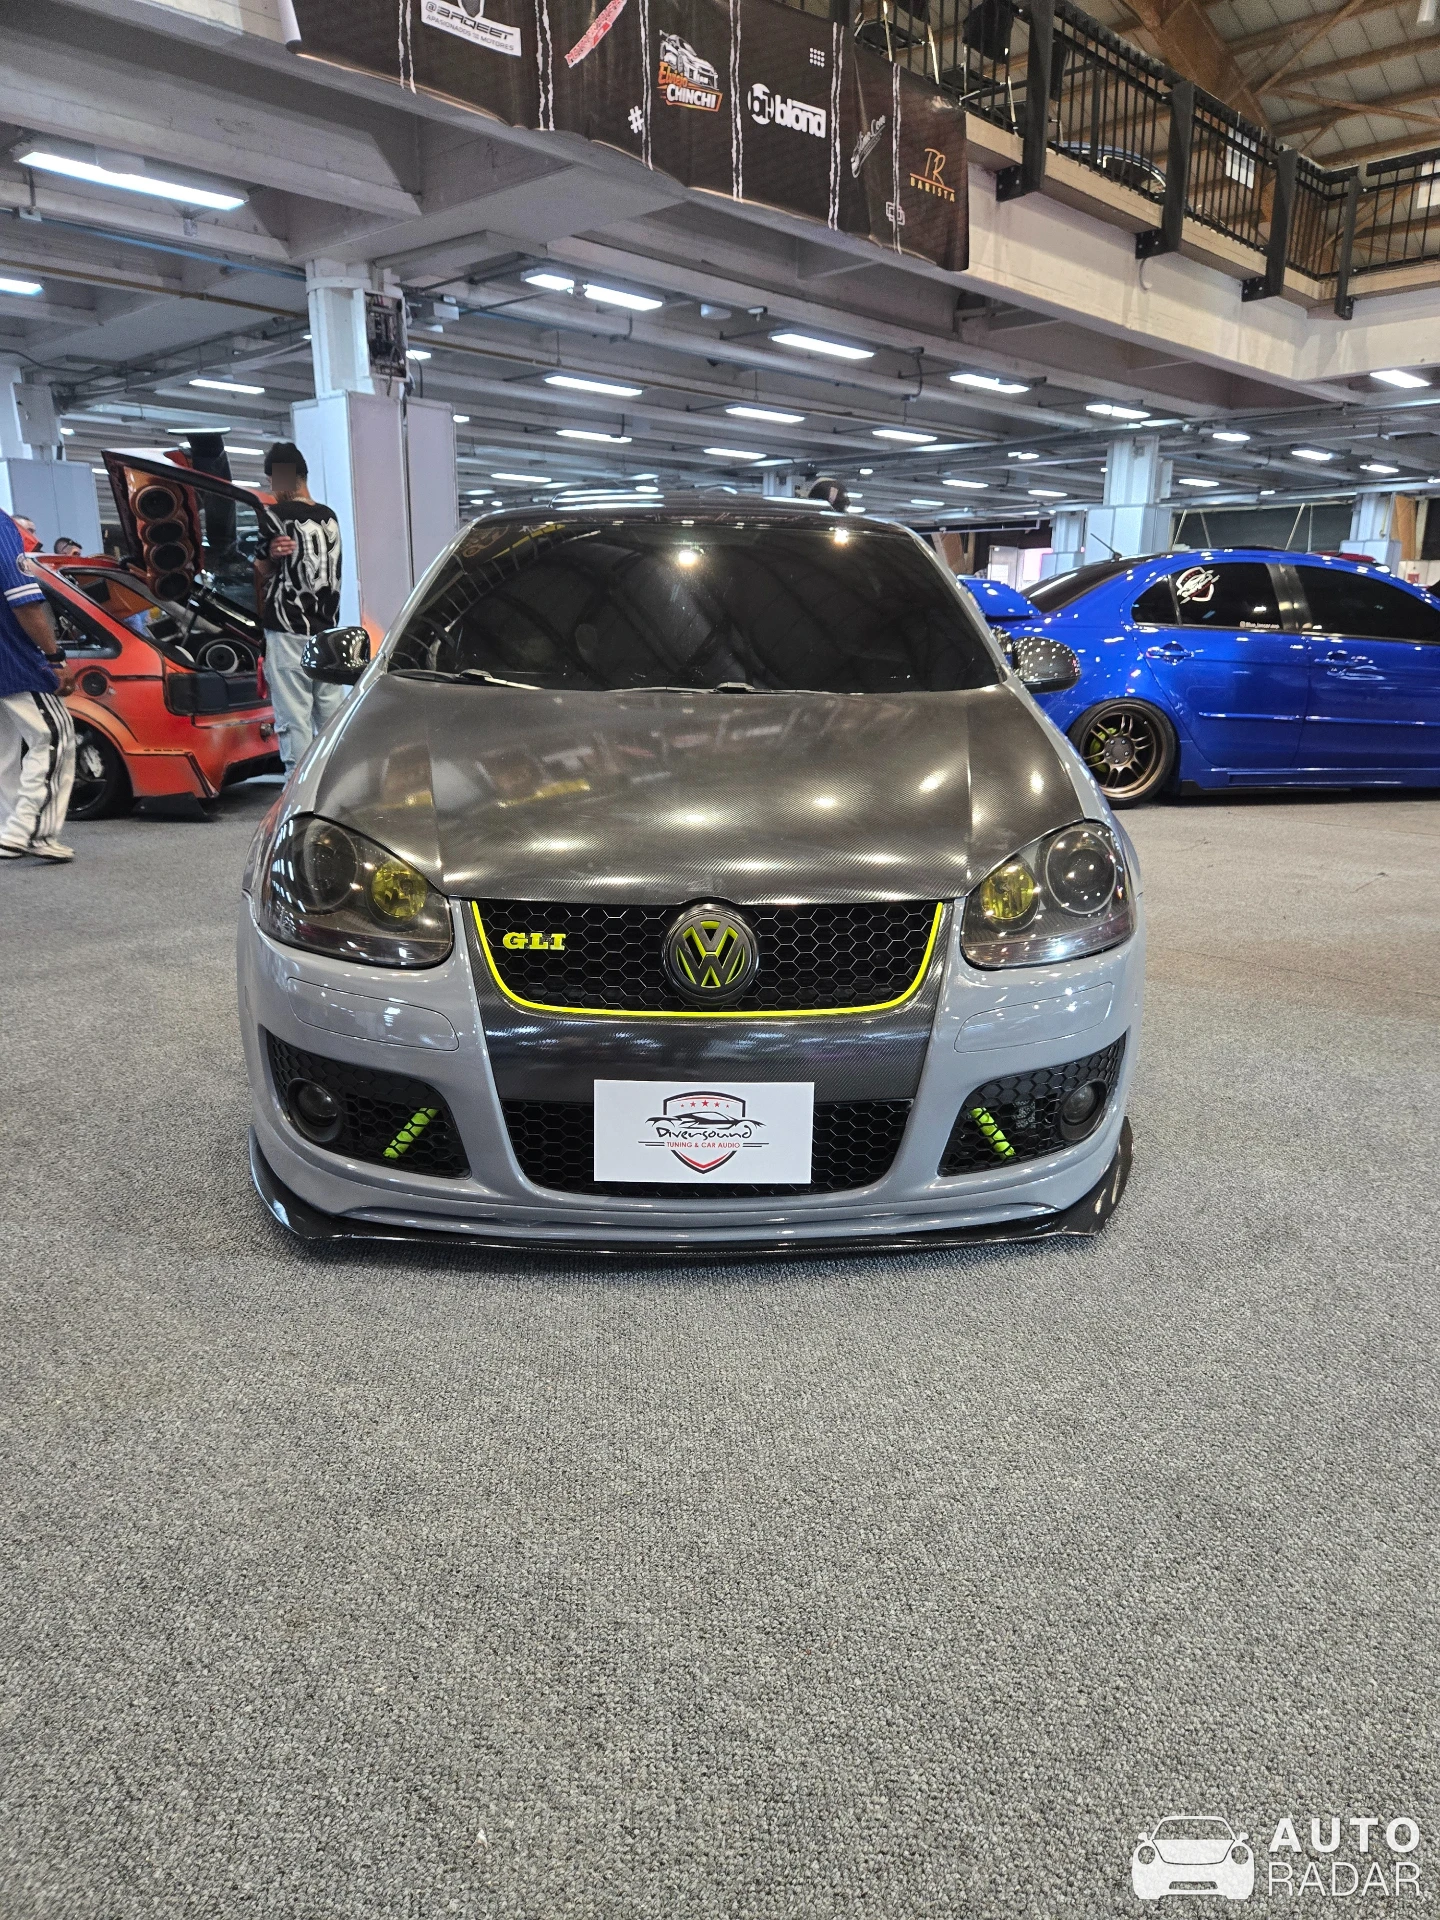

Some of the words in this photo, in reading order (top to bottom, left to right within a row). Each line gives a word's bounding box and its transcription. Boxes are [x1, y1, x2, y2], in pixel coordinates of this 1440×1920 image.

[480, 36, 514, 51] MOTORES
[666, 83, 717, 109] CHINCHI
[775, 94, 827, 139] blond
[910, 176, 955, 203] BARISTA
[502, 931, 567, 951] GLI
[655, 1125, 752, 1140] Diversound
[666, 1141, 693, 1149] TUNING
[701, 1141, 716, 1149] CAR
